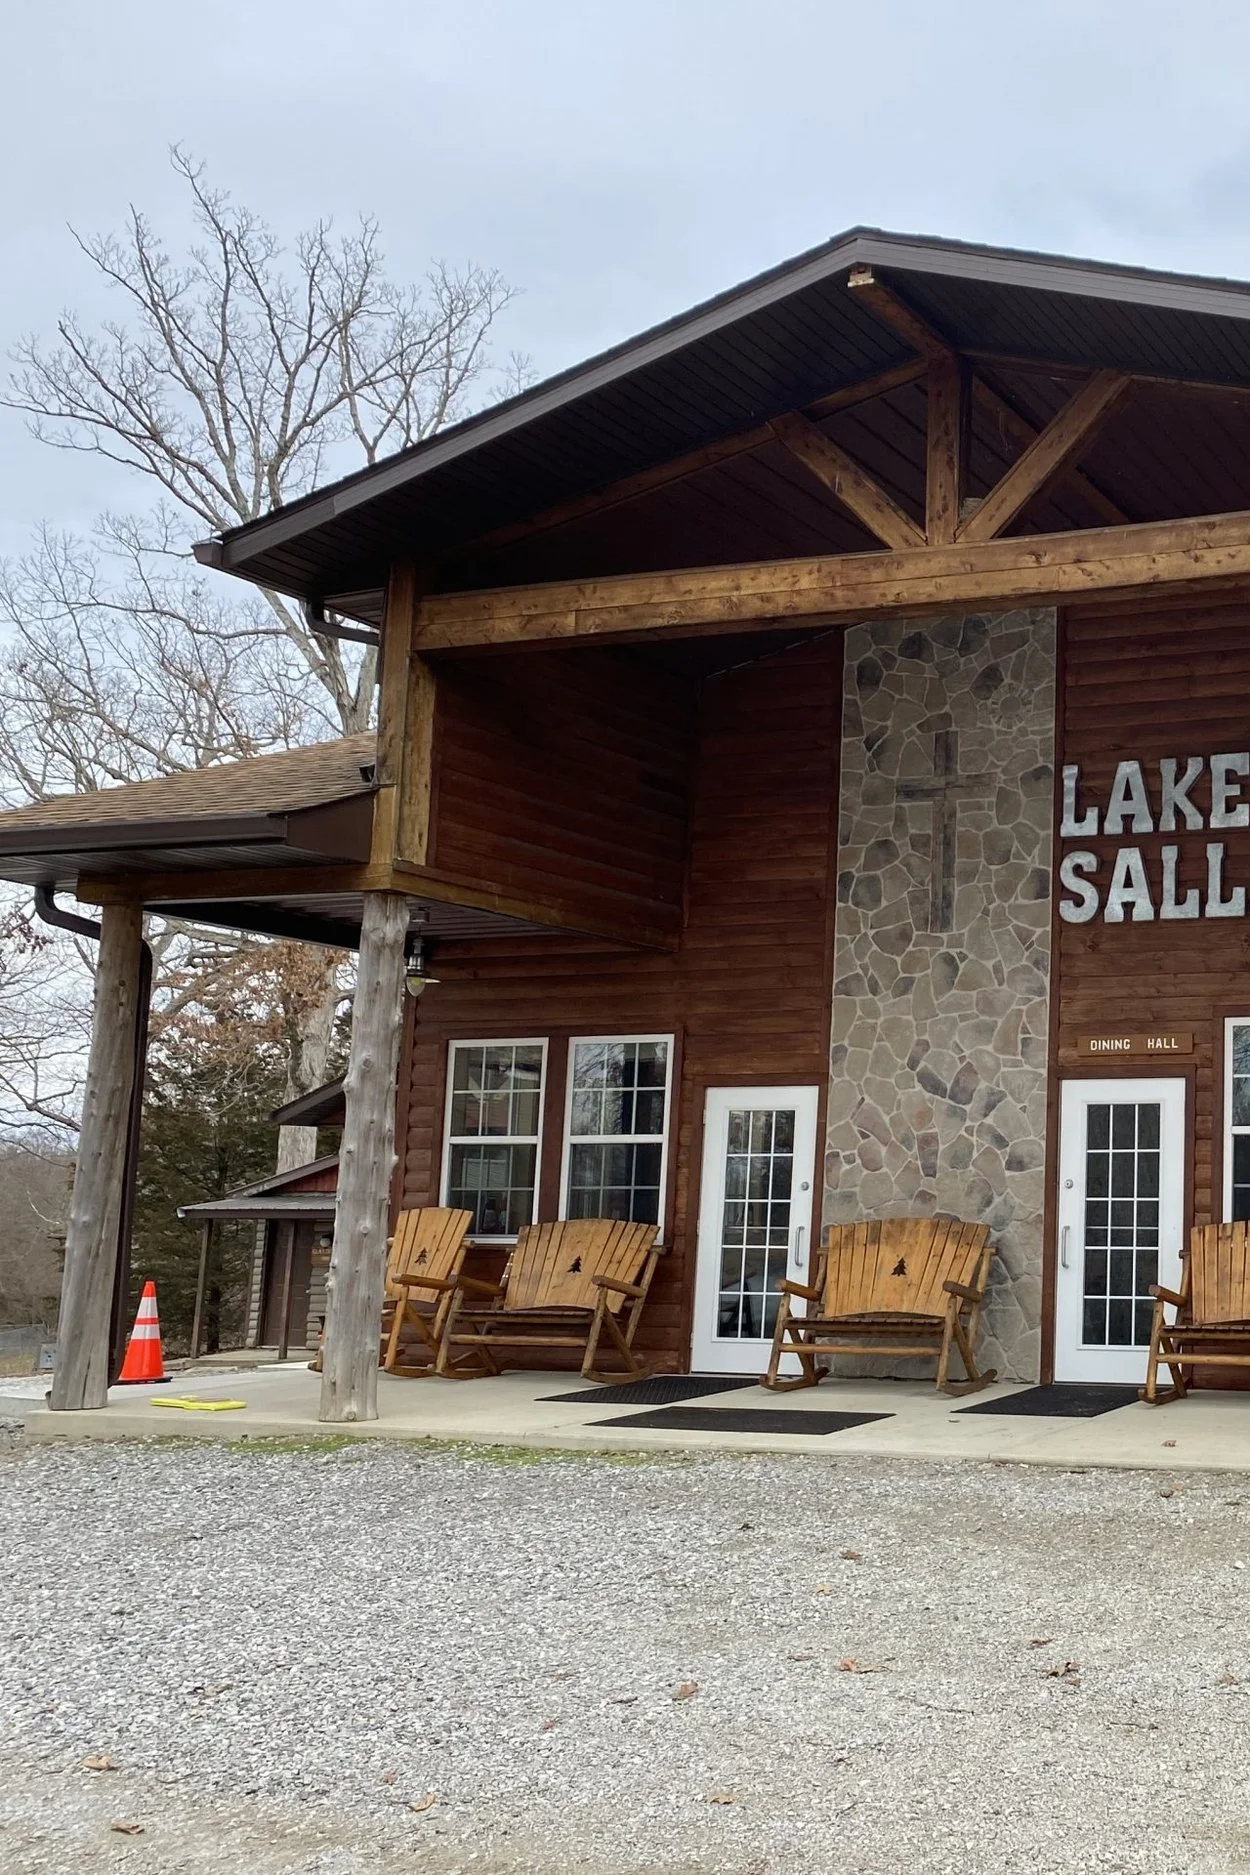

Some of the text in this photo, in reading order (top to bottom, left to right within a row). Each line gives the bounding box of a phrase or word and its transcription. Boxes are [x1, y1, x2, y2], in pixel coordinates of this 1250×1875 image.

[1059, 751, 1250, 838] LAKE
[1090, 1037, 1179, 1051] DINING HALL
